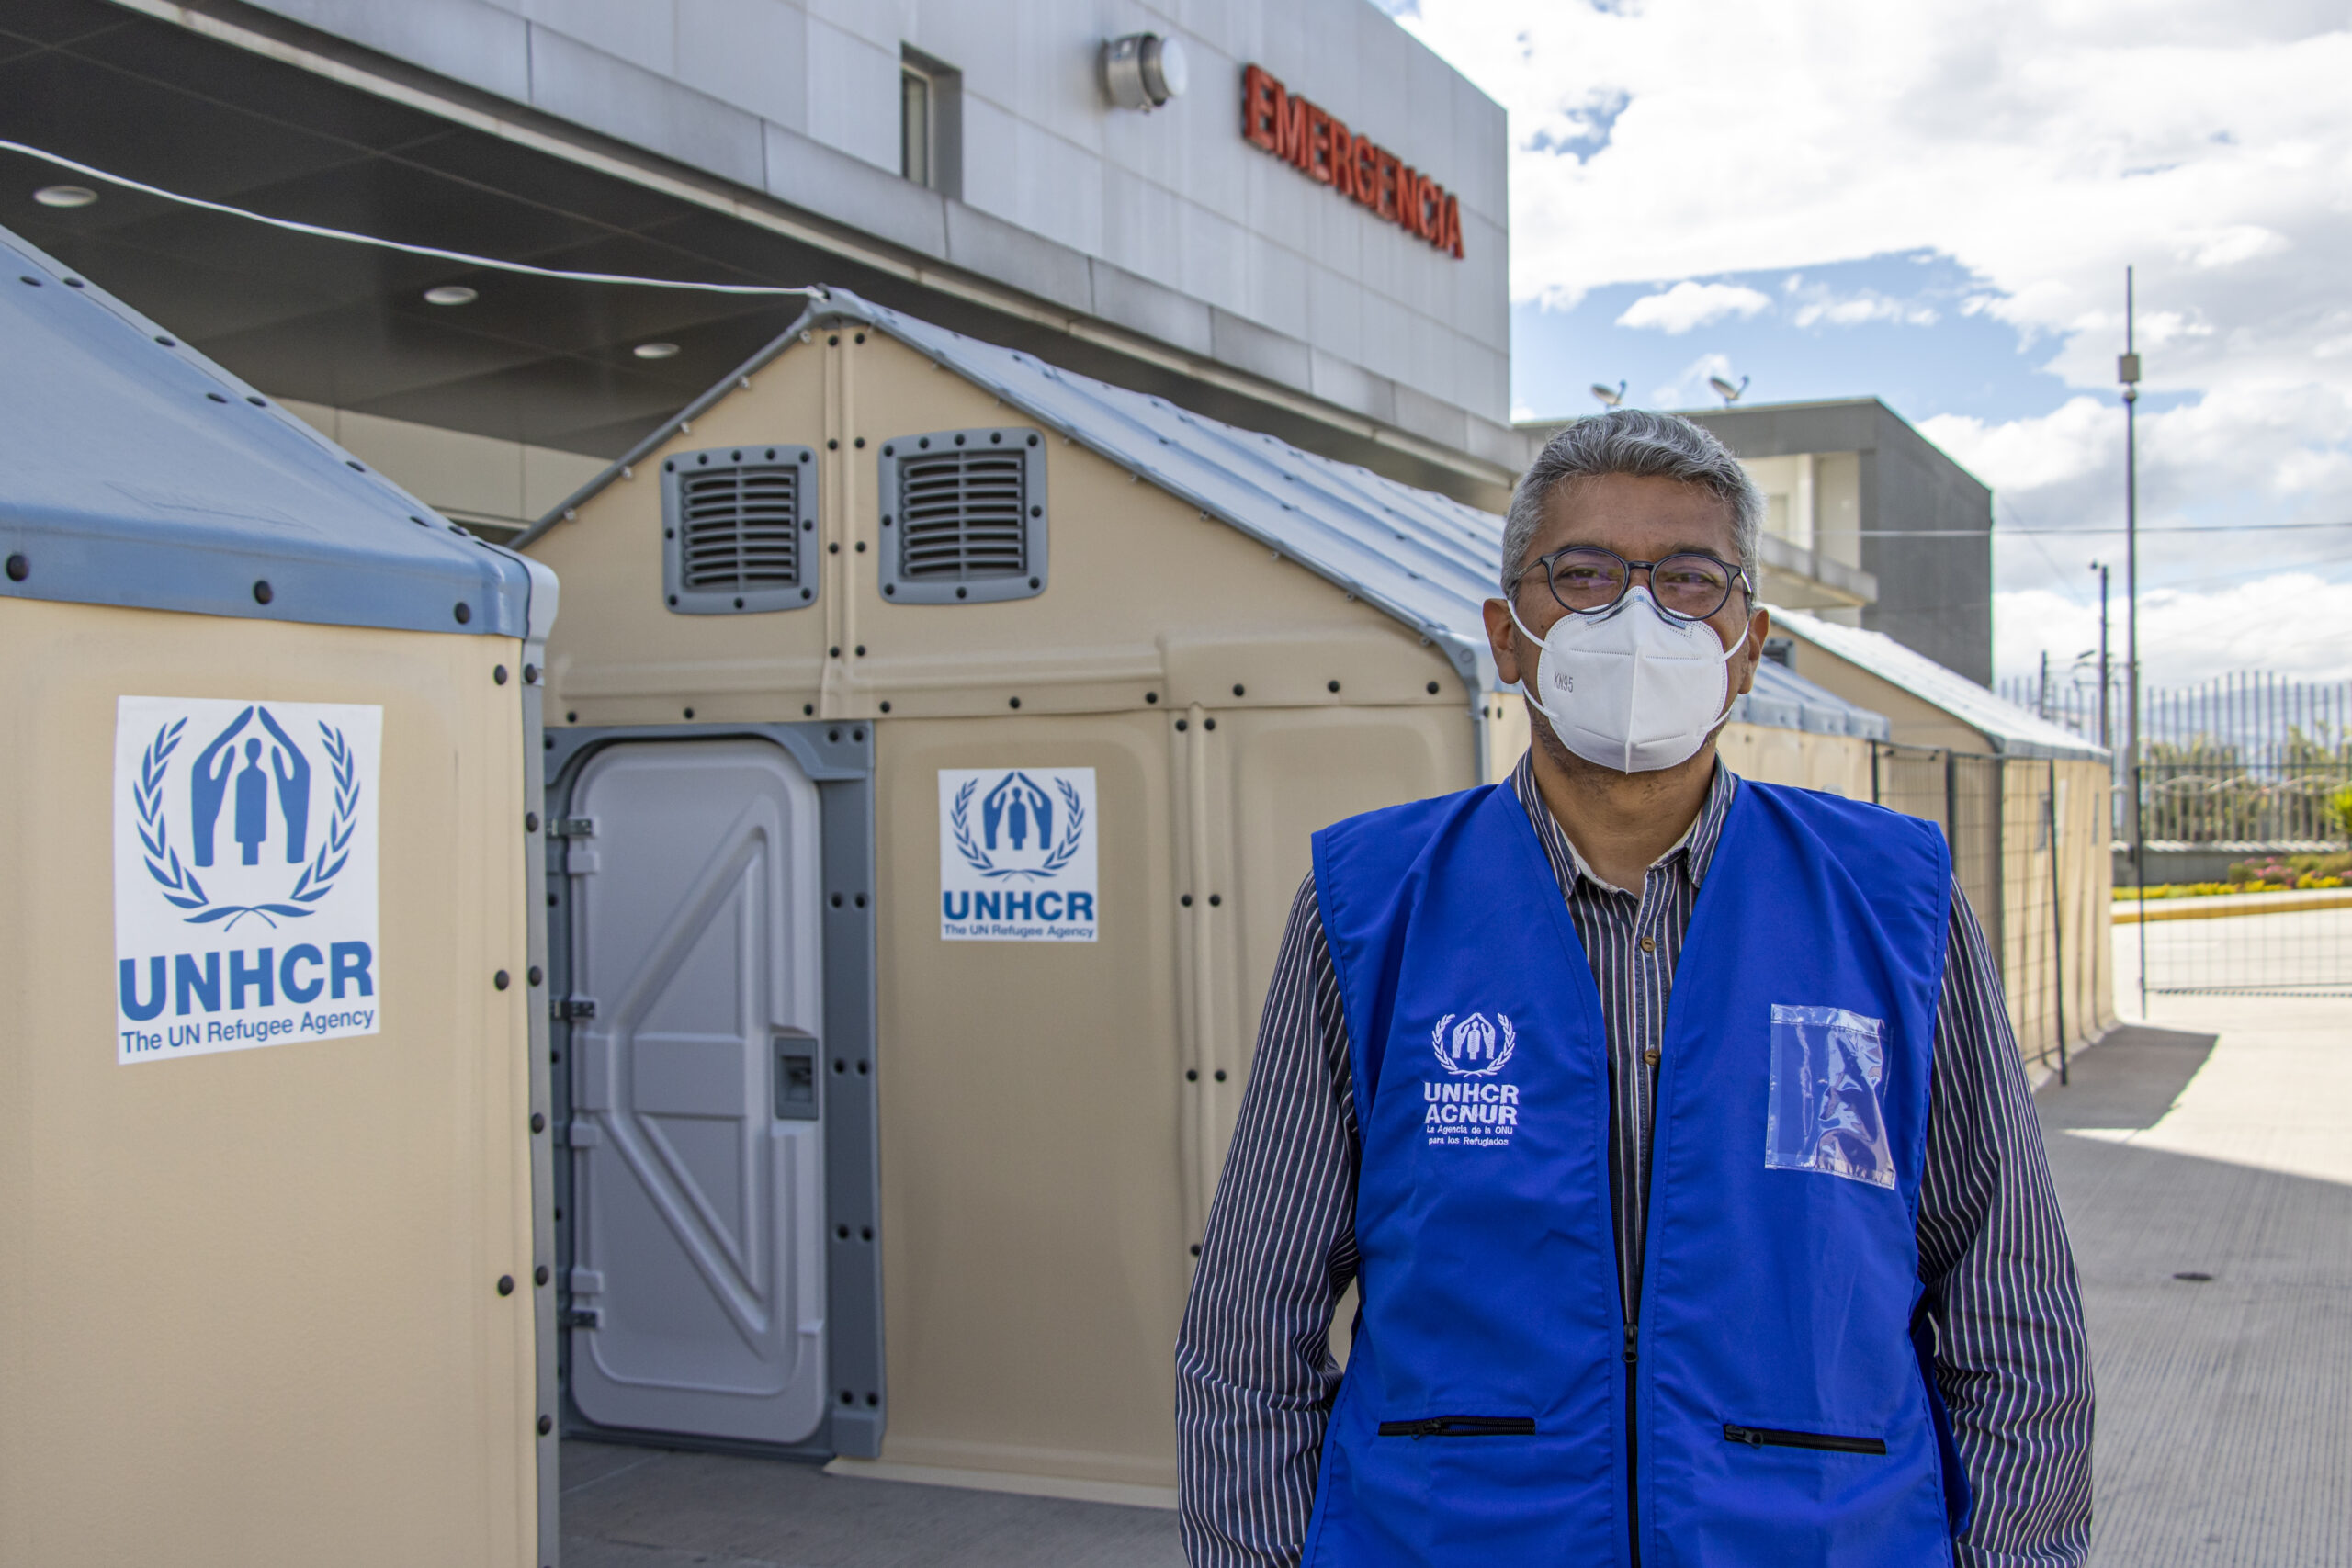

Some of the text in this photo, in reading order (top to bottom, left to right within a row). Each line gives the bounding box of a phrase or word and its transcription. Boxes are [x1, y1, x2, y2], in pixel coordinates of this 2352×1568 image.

[1241, 62, 1464, 259] EMERGENCIA
[1554, 671, 1573, 693] KN95
[944, 890, 1093, 922] UNHCR
[944, 924, 1094, 938] The UN Refugee Agency
[119, 941, 374, 1021] UNHCR
[121, 1009, 375, 1054] The UN Refugee Agency
[1424, 1082, 1520, 1105] UNHCR
[1425, 1104, 1518, 1125] ACNUR
[1426, 1125, 1513, 1134] La Agencia de la ONU
[1428, 1136, 1510, 1147] para los Refugiados
